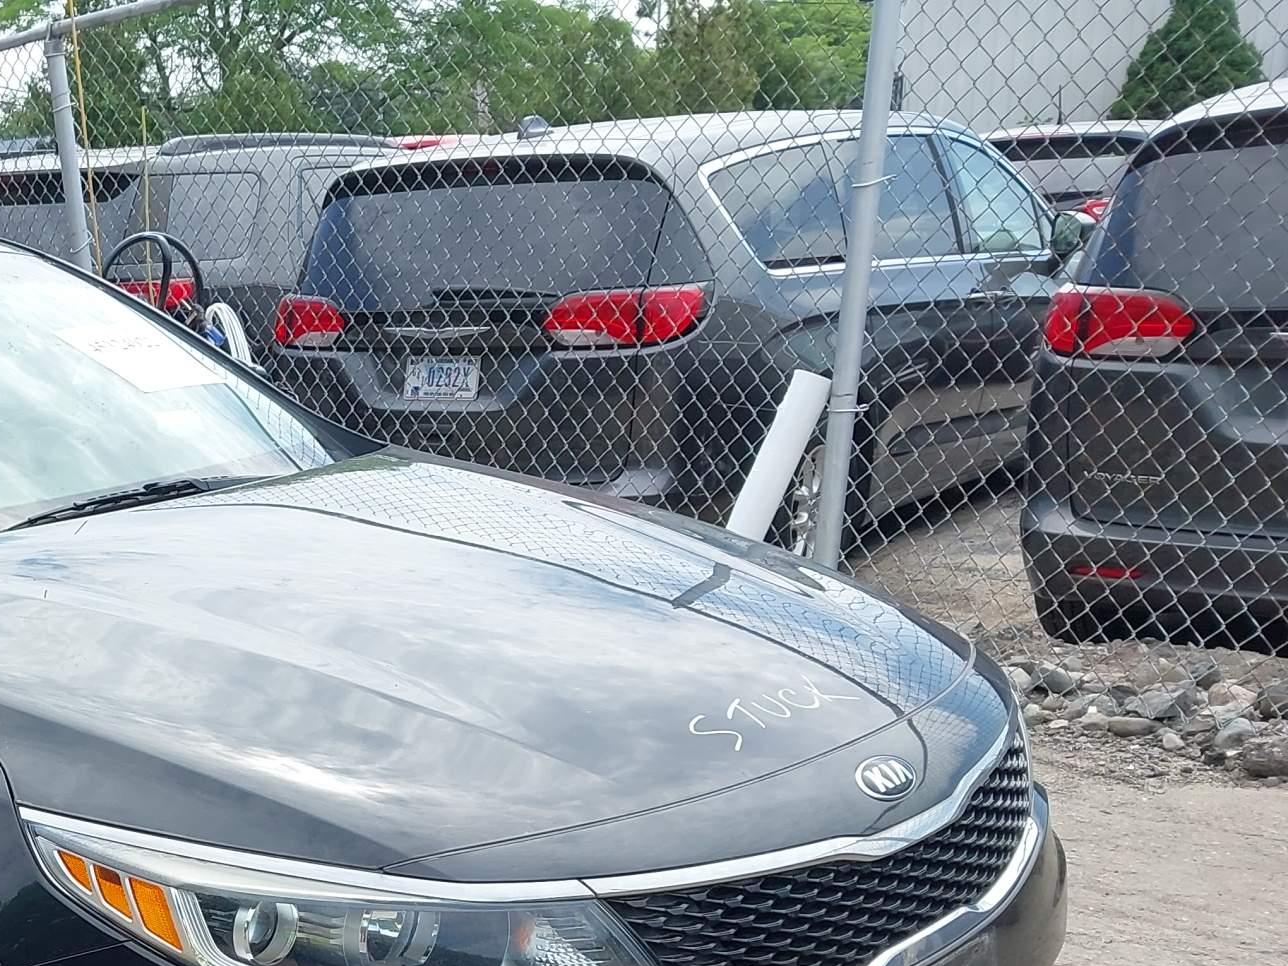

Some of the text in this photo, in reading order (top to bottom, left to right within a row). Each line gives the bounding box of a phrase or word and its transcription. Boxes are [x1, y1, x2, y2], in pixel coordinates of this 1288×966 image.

[1083, 471, 1162, 485] VOYAGER
[688, 675, 860, 752] STUCK
[863, 759, 913, 793] KIA
